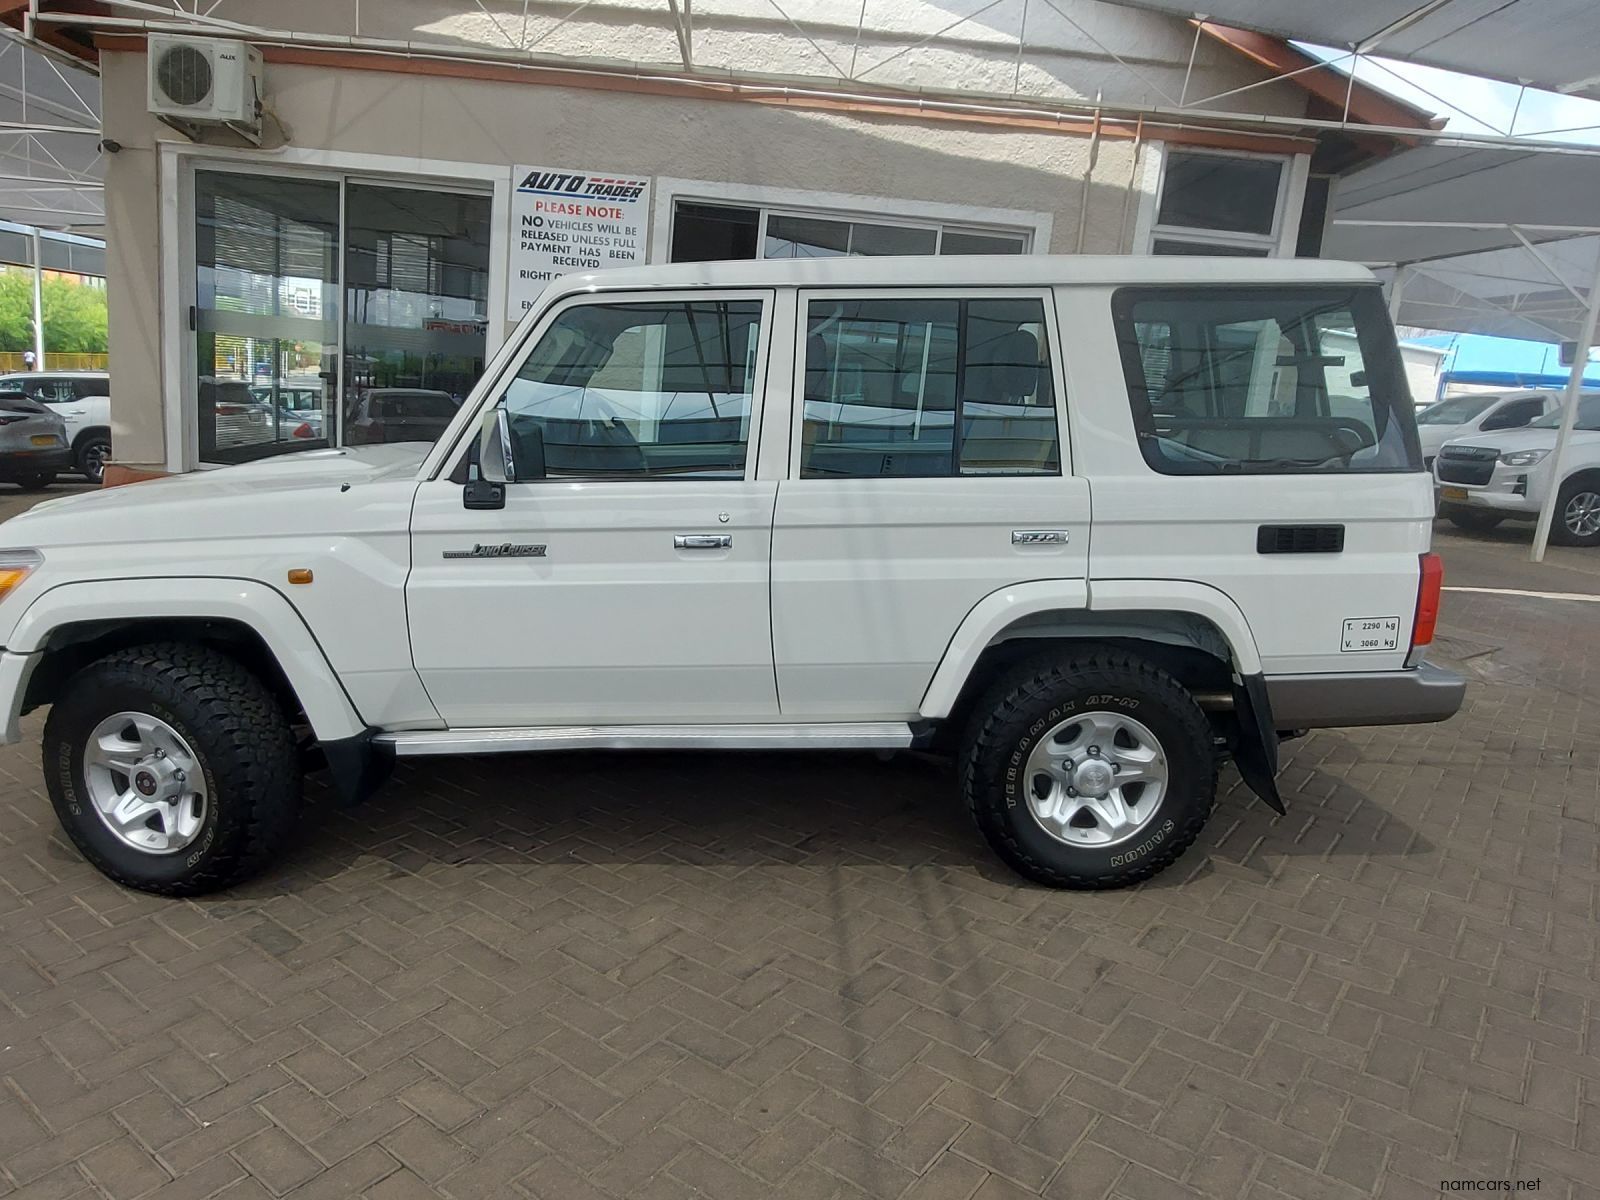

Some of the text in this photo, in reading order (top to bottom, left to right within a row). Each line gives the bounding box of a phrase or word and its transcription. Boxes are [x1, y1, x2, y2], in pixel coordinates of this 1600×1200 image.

[519, 171, 644, 198] AUTO TRADER
[535, 200, 625, 220] PLEASE NOTE:
[522, 215, 637, 236] NO VEHICLES WILL BE
[521, 230, 636, 249] RELEASED UNLESS FULL
[520, 242, 635, 260] PAYMENT HAS BEEN
[552, 256, 600, 268] RECEIVED
[519, 270, 552, 281] RIGHT
[1362, 622, 1381, 630] 2290
[1385, 621, 1396, 630] kg
[1384, 638, 1395, 648] kg
[1110, 818, 1176, 867] SAILUN
